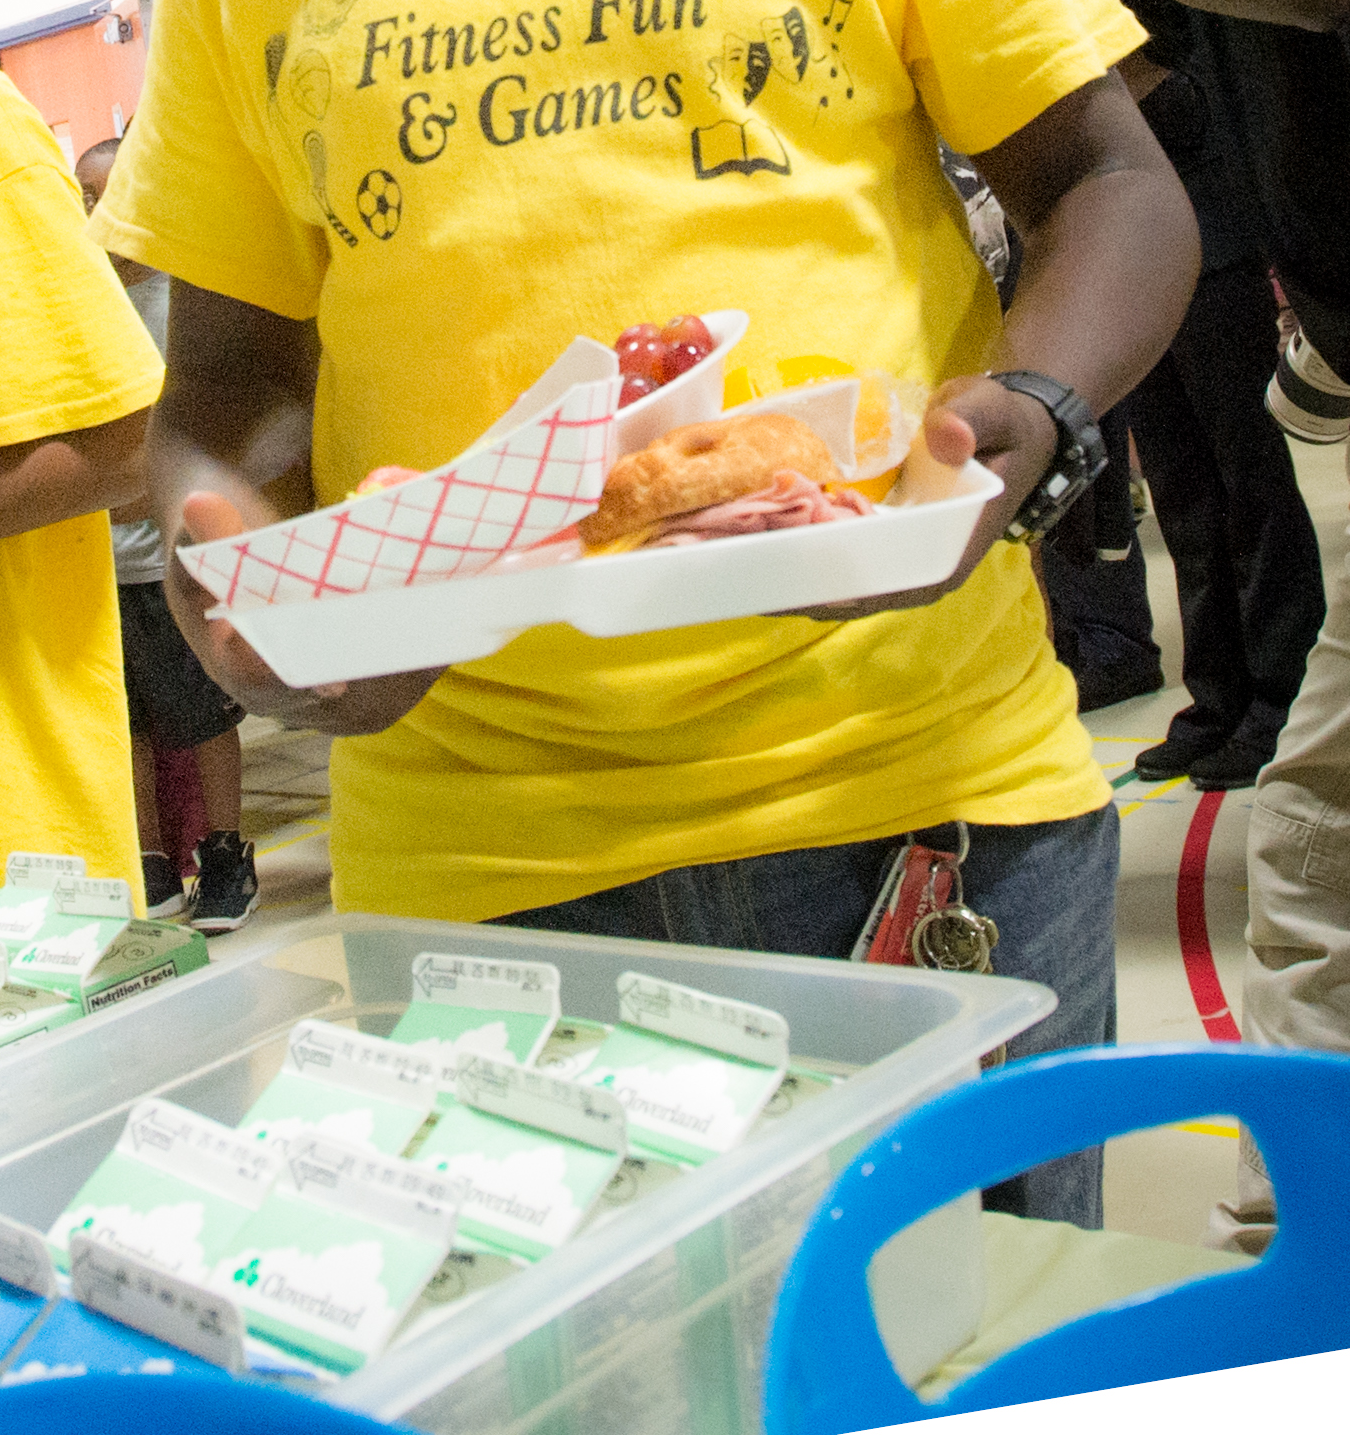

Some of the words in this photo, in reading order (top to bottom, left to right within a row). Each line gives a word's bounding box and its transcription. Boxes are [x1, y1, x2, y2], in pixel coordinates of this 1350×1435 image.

[356, 4, 562, 90] Fitness
[398, 91, 457, 165] &
[478, 70, 684, 148] Games
[34, 946, 86, 966] Cloverland
[90, 982, 142, 1011] Nutrition
[143, 966, 176, 991] Facts
[617, 1086, 714, 1135] Cloverland
[259, 1274, 366, 1330] Cloverland
